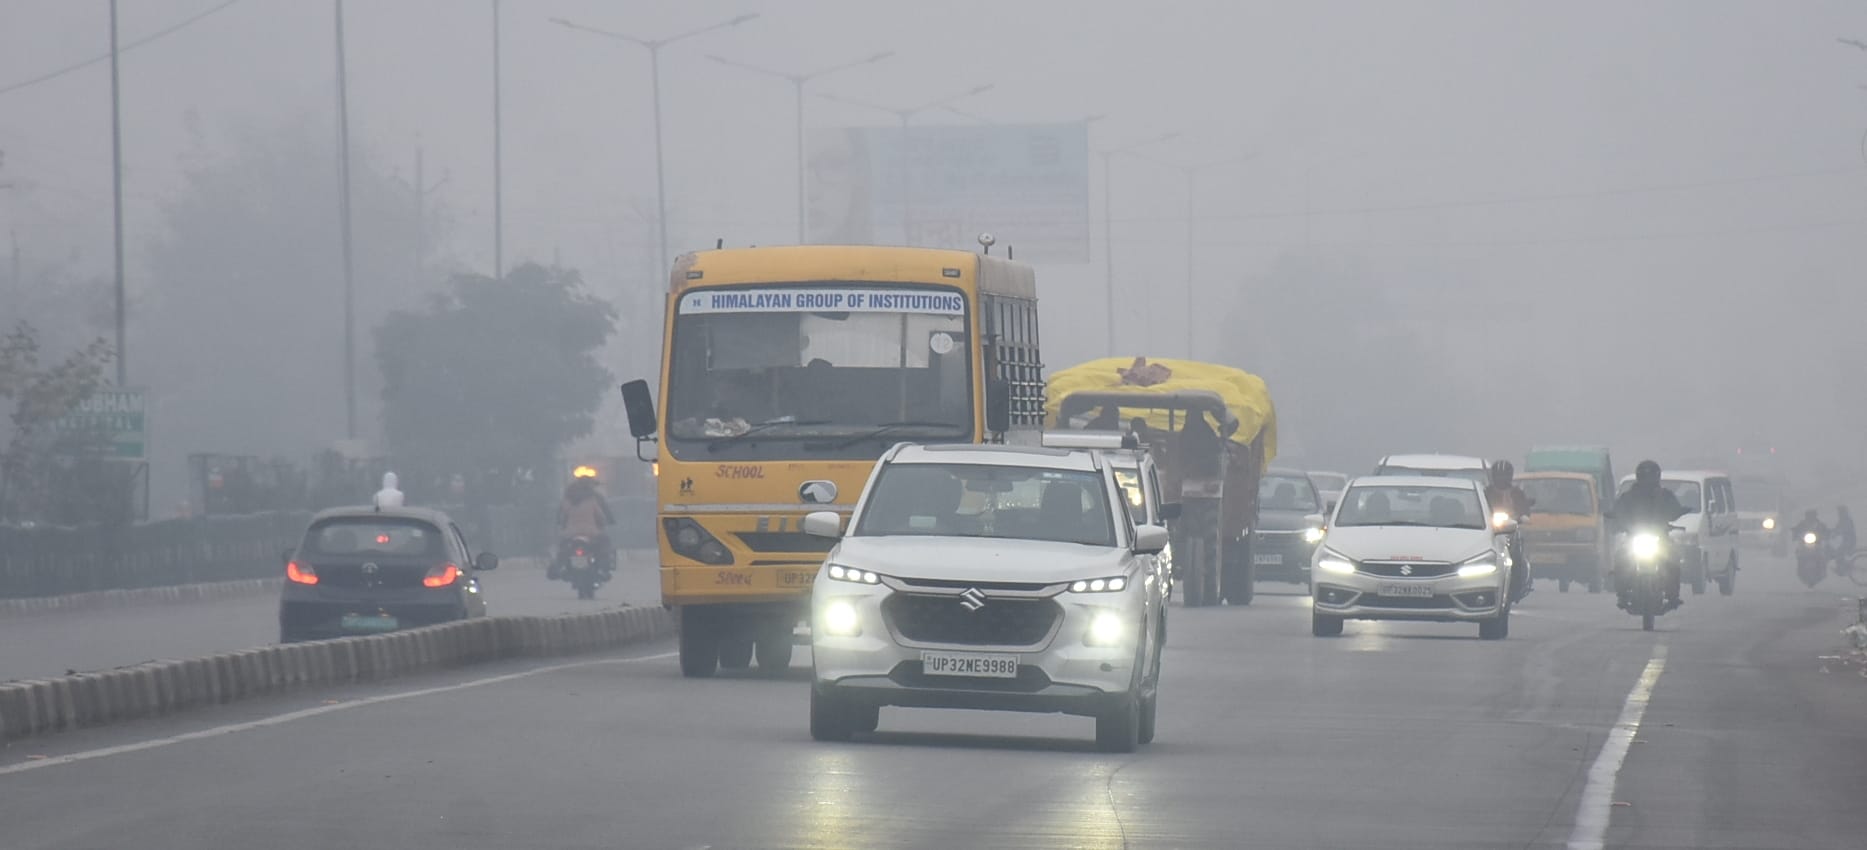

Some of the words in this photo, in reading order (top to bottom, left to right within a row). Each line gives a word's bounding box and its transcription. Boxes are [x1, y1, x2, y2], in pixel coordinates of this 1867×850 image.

[711, 293, 791, 309] HIMALAYAN
[796, 293, 842, 308] GROUP
[847, 293, 864, 308] OF
[869, 294, 961, 311] INSTITUTIONS
[75, 392, 144, 412] UBHAM
[715, 464, 765, 479] SCHOOL
[932, 657, 1015, 674] UP32NE9988
